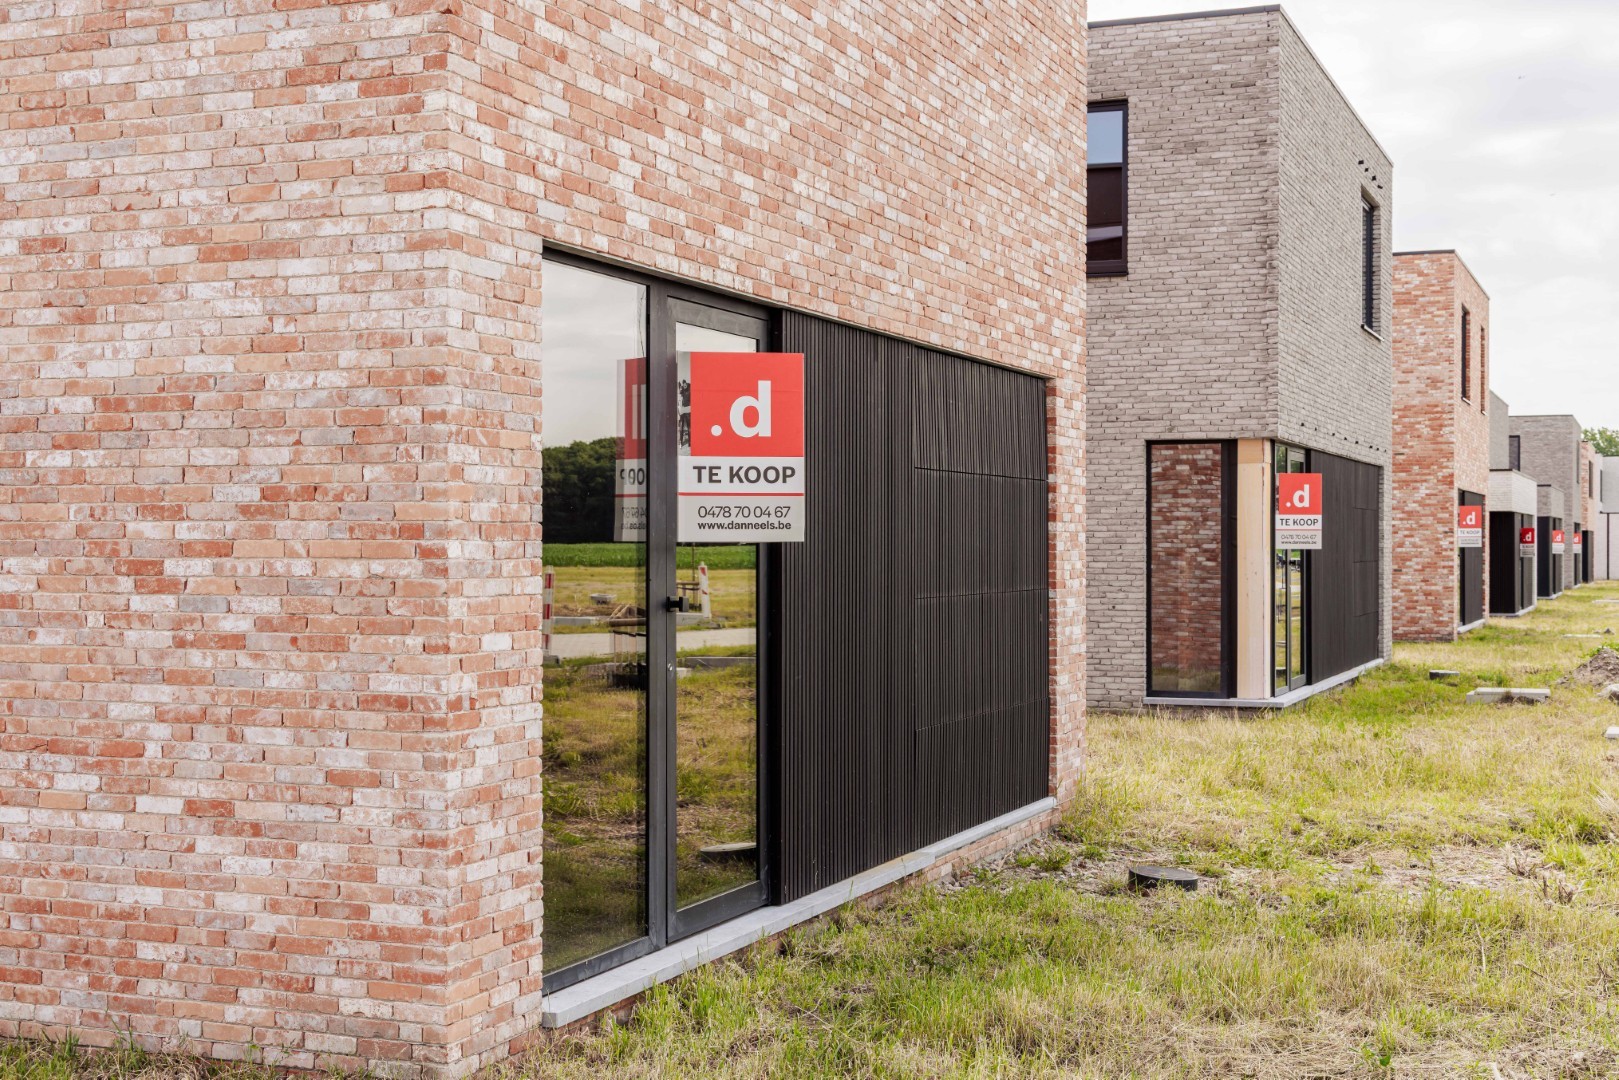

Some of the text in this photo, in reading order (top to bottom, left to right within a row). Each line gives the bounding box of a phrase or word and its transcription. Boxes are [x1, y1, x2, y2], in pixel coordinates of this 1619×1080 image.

[692, 465, 796, 484] TE KOOP
[697, 506, 791, 518] 0478 70 04 67
[697, 520, 791, 530] www.danneels.be
[1280, 518, 1318, 526] TE KOOP
